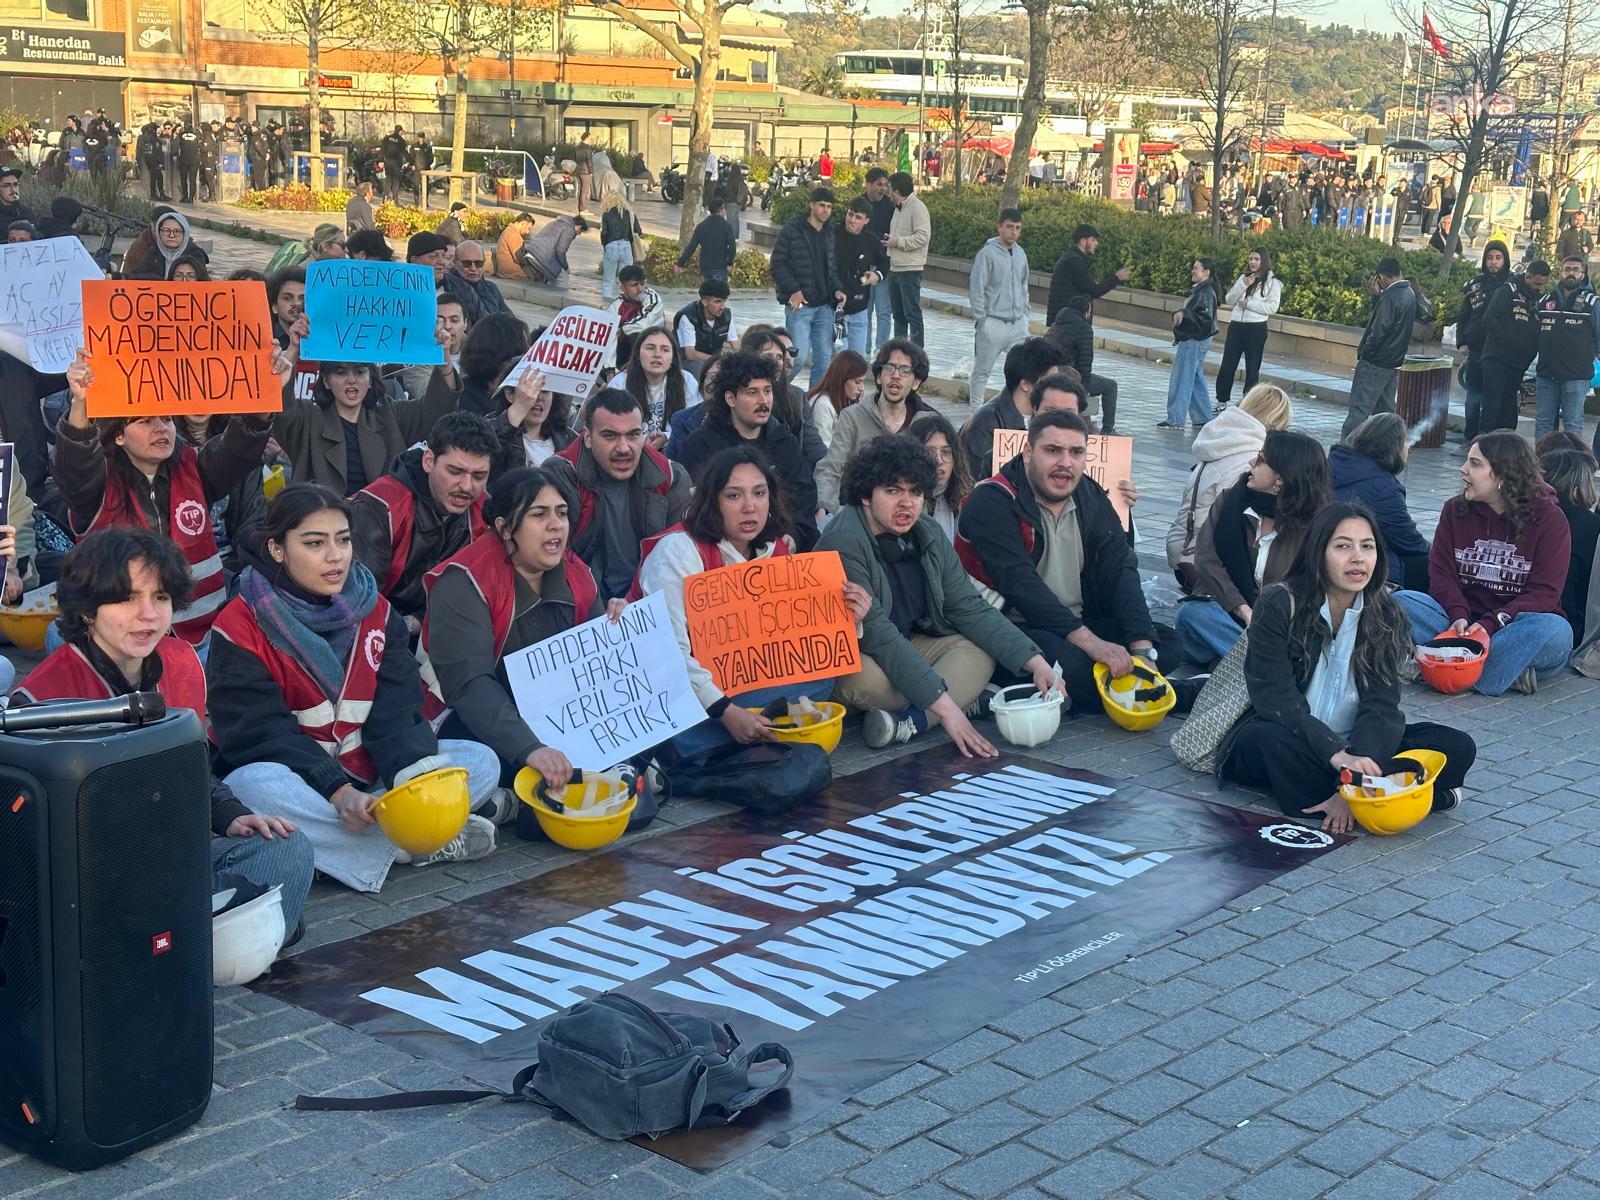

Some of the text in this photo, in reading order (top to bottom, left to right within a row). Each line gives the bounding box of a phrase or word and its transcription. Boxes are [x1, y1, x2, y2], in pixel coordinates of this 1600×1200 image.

[11, 29, 91, 50] Et Hanedan
[136, 17, 172, 25] RESTAURANT
[23, 48, 126, 67] Restaurantları Balık
[3, 240, 87, 273] FAZLA
[48, 270, 67, 298] AY
[311, 266, 430, 292] MADENCİNİN
[109, 287, 236, 322] ÖĞRENCİ
[346, 294, 412, 318] HAKKINI
[88, 320, 261, 356] MADENCİNİN
[335, 320, 408, 352] VER!
[116, 354, 261, 404] YANINDA!
[688, 555, 821, 613] GENÇLİK
[526, 603, 657, 680] MADENCİNİN
[691, 611, 750, 648] MADEN
[571, 642, 639, 692] HAKKI
[713, 630, 855, 692] YANINDA
[545, 668, 653, 735] VERİLSİN
[589, 690, 678, 754] ARTIK!
[673, 764, 1117, 913] İŞÇİLERİNİN
[156, 937, 169, 949] JBL
[651, 826, 1174, 1032] YANINDAYIZ!
[357, 889, 770, 1045] MADEN
[1046, 930, 1125, 968] ÖĞRENCİLER
